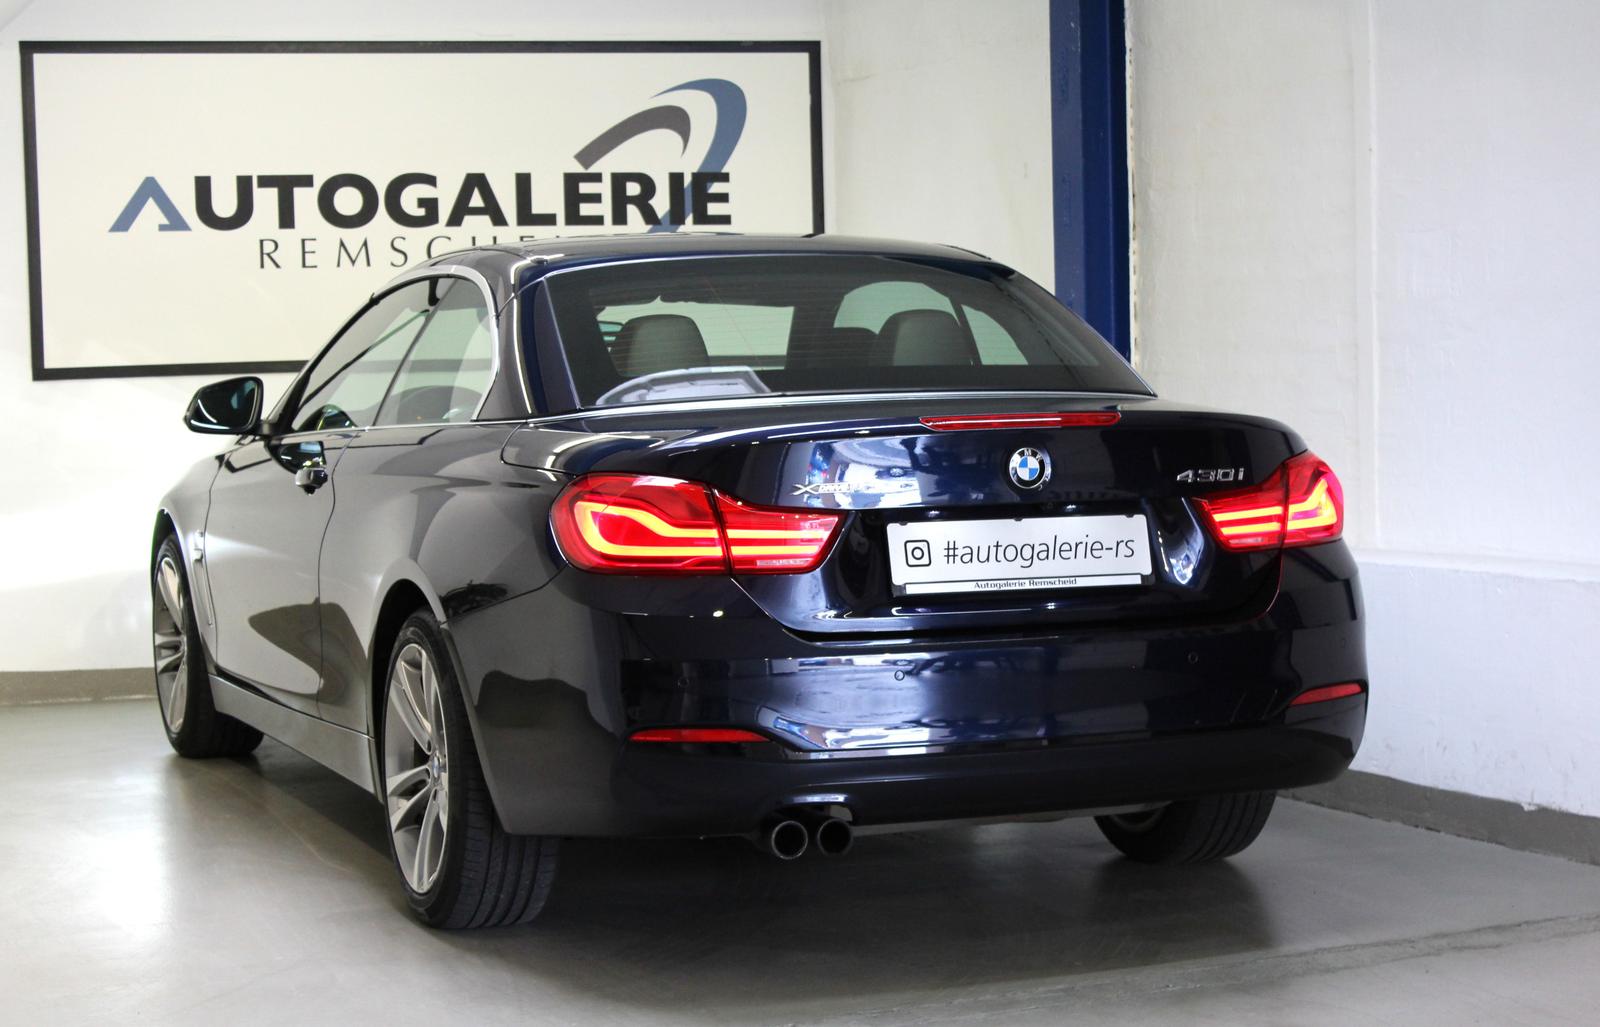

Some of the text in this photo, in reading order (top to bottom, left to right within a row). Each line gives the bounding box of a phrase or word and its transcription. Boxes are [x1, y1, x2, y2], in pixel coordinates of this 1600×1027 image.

[107, 171, 732, 232] AUTOGALERIE
[258, 235, 560, 269] REMSC
[943, 534, 1136, 569] #autogalerie-rs
[974, 577, 1078, 590] Autogalerie Remscheid
